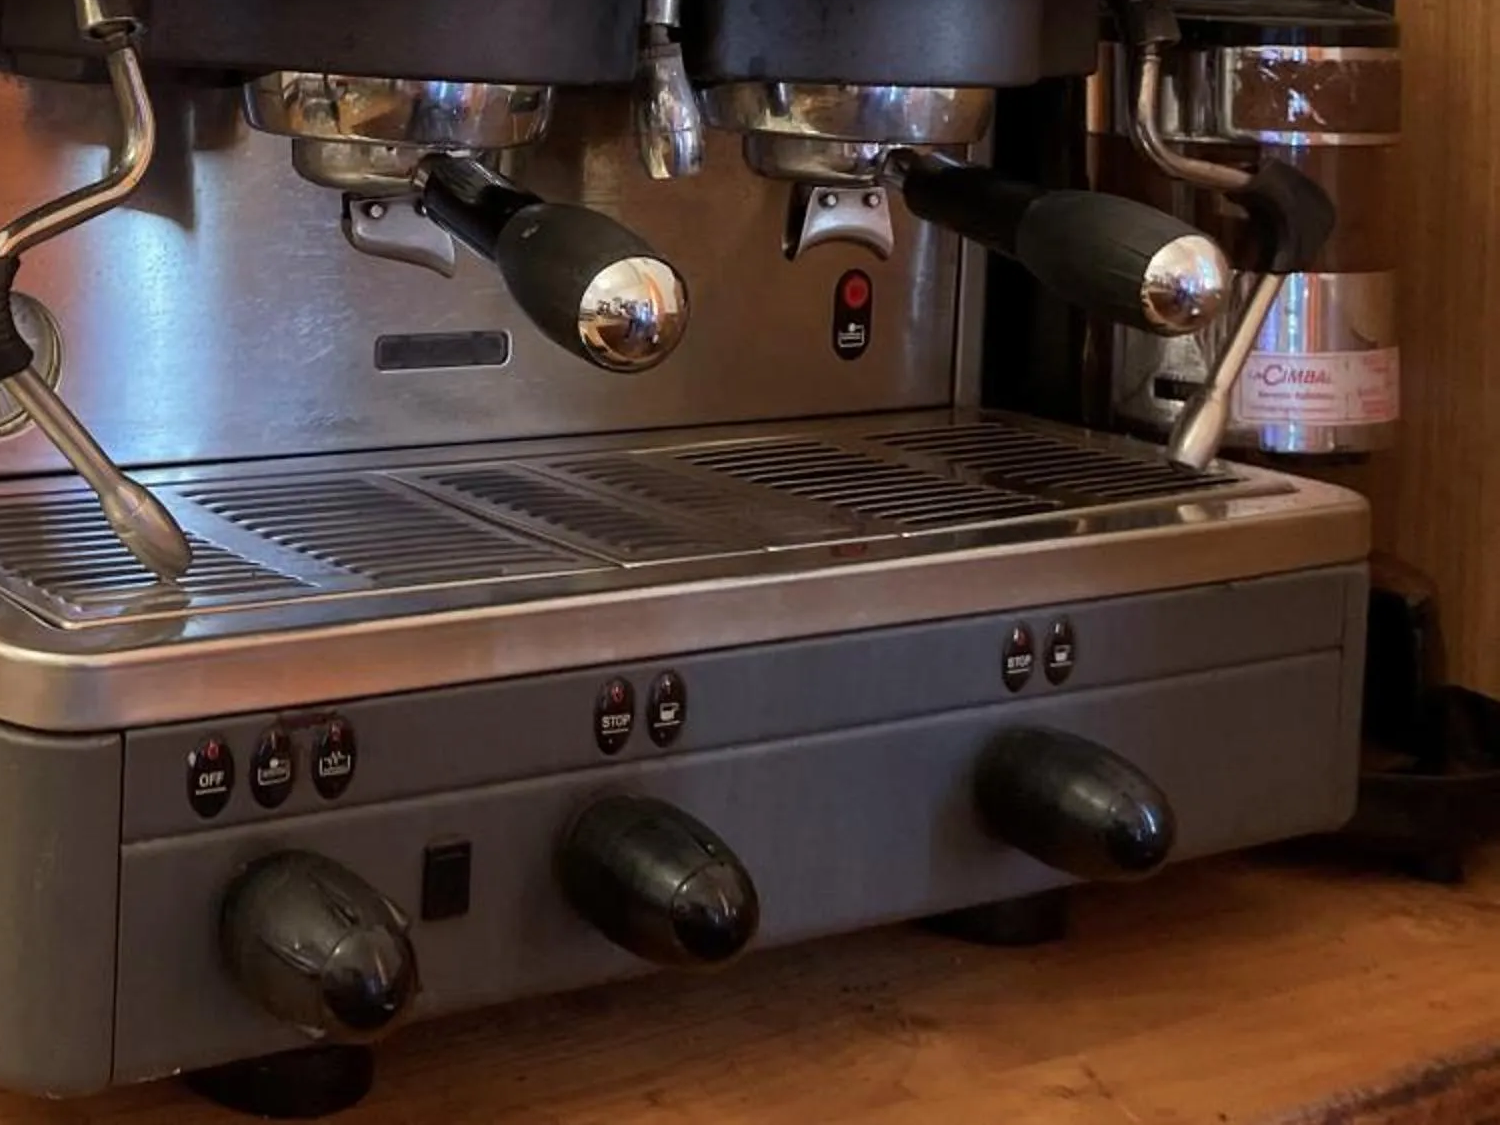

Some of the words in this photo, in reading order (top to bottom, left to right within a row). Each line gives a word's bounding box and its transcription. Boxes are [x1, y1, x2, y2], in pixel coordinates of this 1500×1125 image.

[1006, 653, 1032, 668] STOP
[601, 714, 631, 728] STOP
[199, 771, 226, 788] OFF
